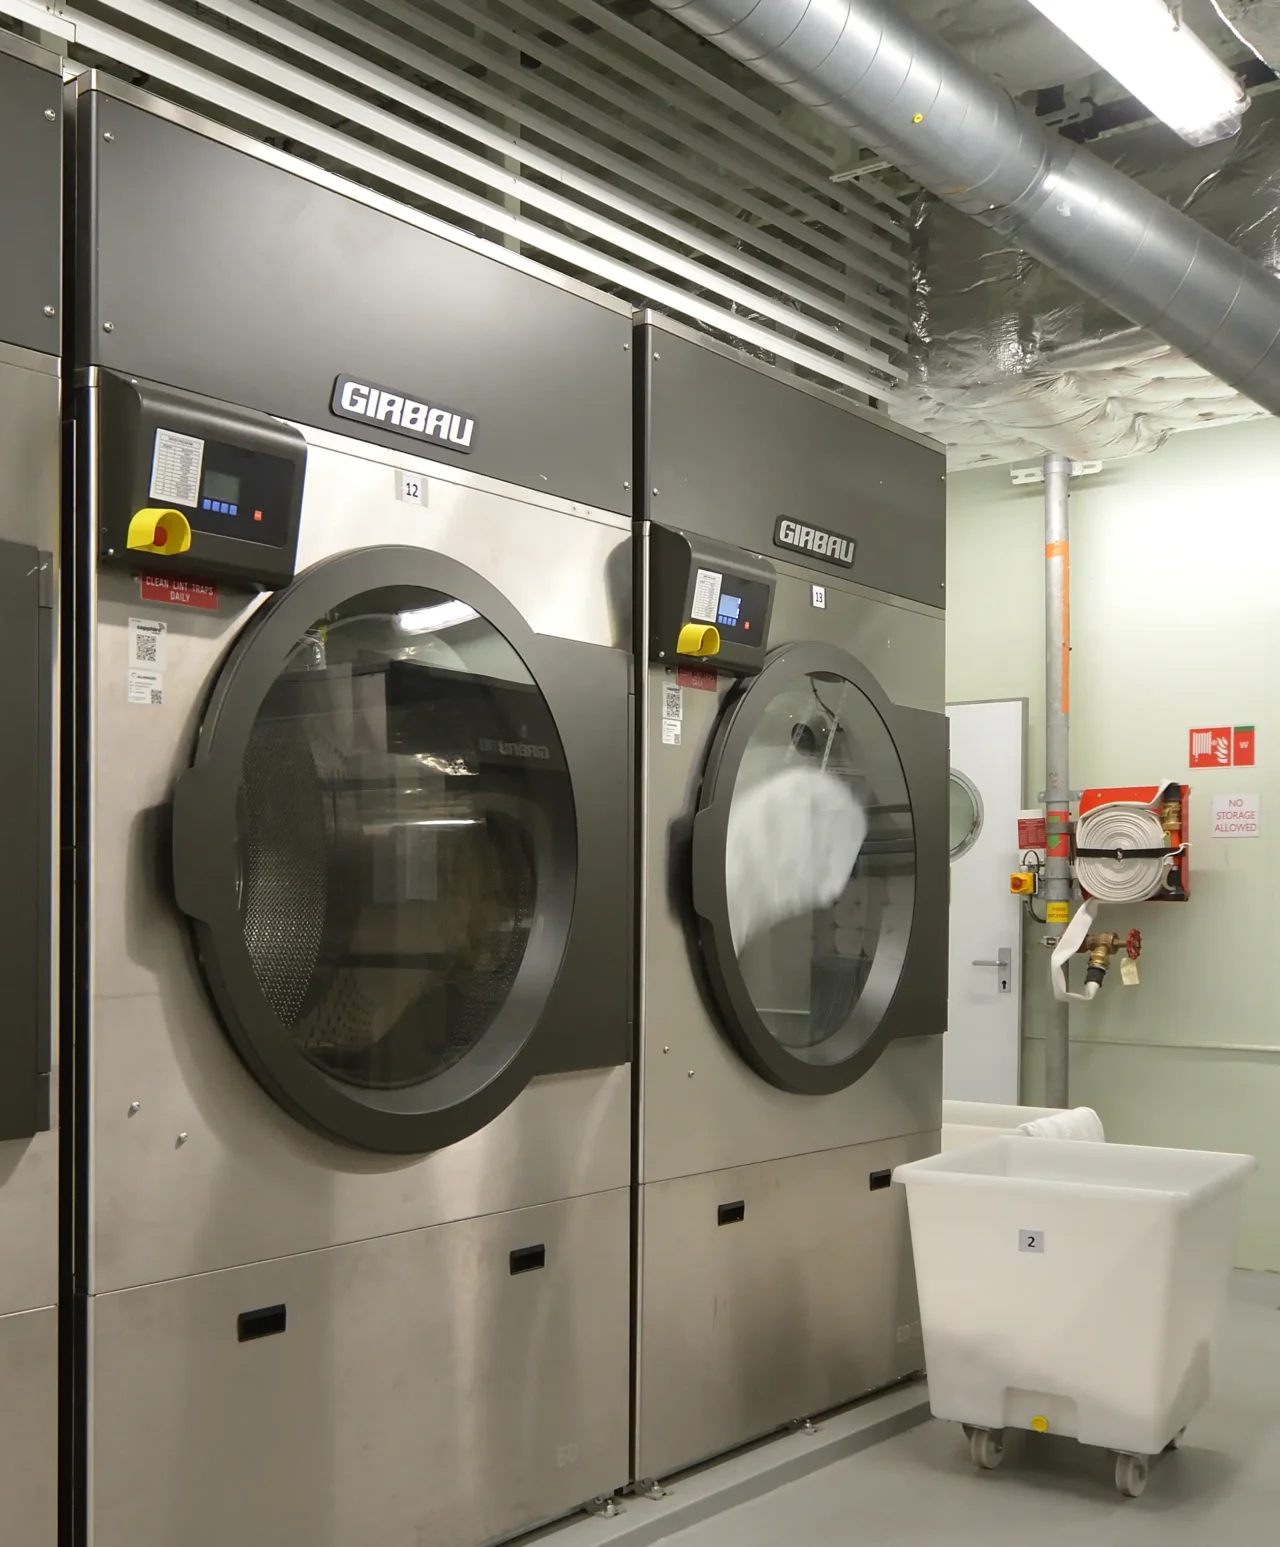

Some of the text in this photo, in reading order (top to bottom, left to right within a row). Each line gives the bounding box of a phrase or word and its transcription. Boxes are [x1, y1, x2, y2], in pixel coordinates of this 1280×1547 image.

[340, 381, 474, 447] GIRBAU
[405, 482, 419, 498] 12
[779, 520, 855, 563] GIRBAU
[145, 576, 214, 596] CLEAN LINT TRAPS
[170, 591, 190, 602] DAILY
[815, 592, 823, 603] 13
[1228, 799, 1244, 807] NO
[1216, 811, 1256, 820] STORAGE
[1215, 823, 1257, 832] ALLOWED
[1027, 1236, 1037, 1248] 2
